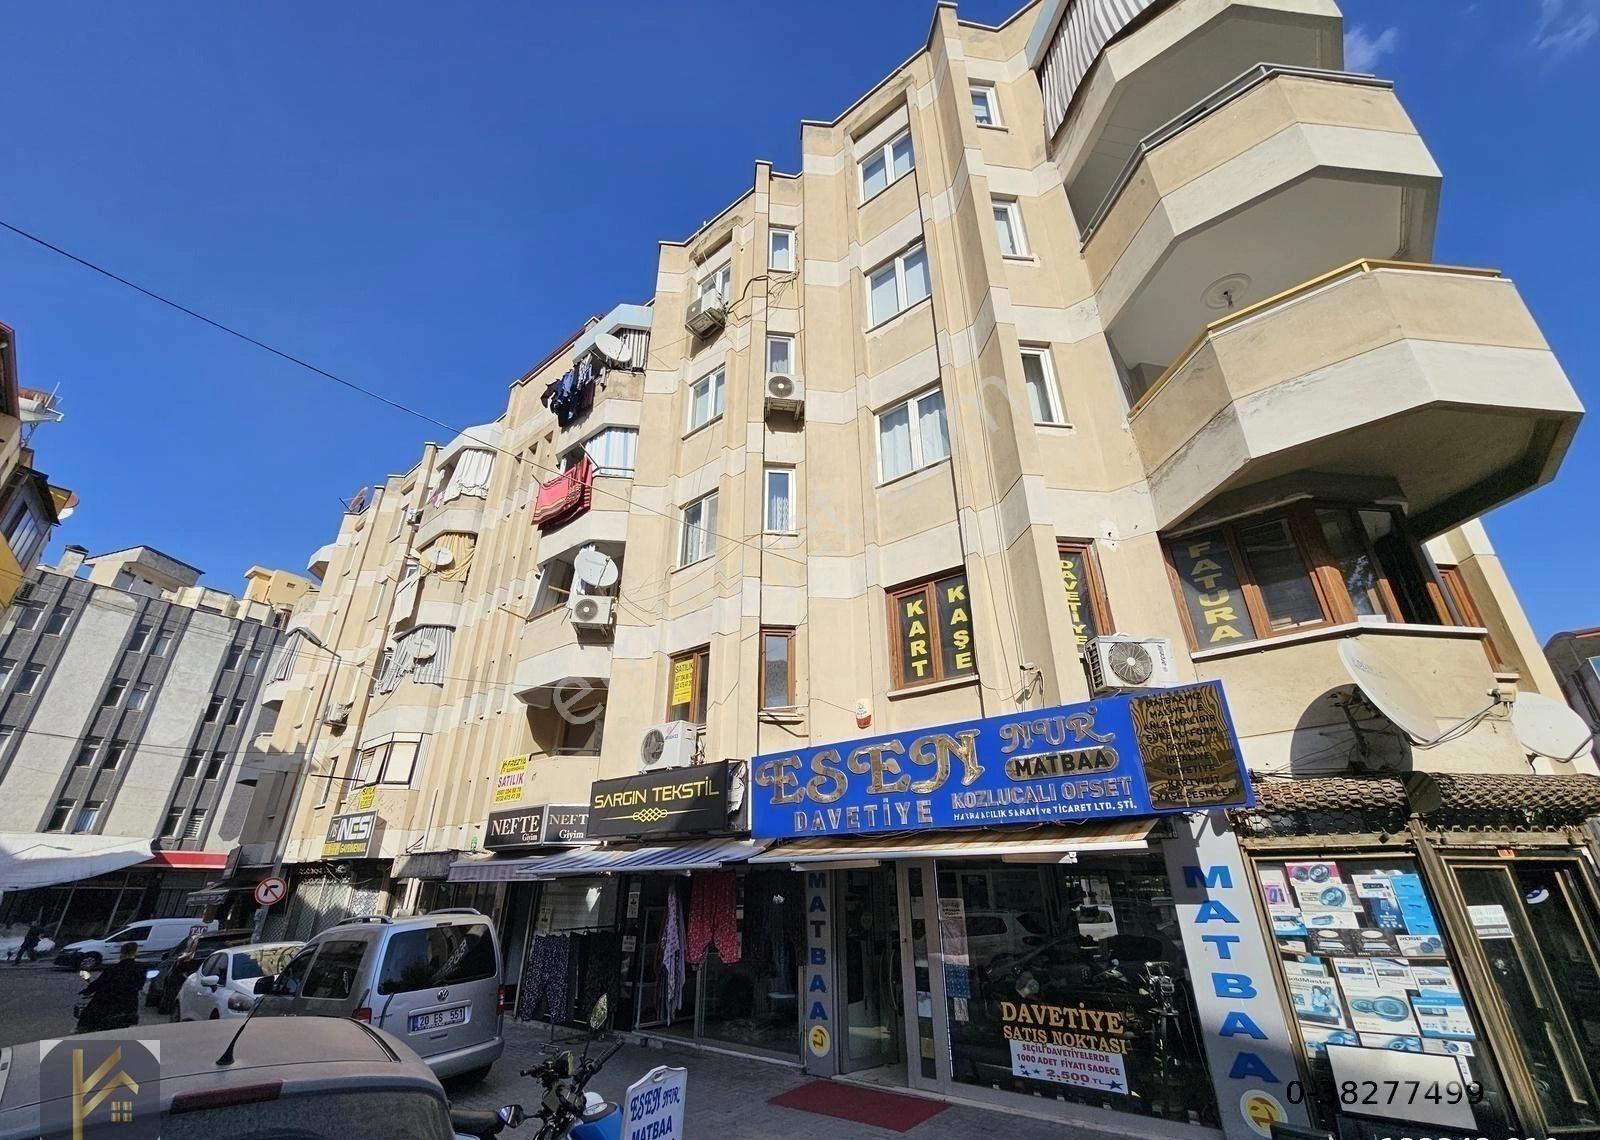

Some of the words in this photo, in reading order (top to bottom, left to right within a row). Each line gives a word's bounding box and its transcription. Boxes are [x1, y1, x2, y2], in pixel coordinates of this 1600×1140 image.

[1188, 541, 1243, 642] FATURA
[906, 599, 928, 677] KART
[948, 585, 972, 670] KAŞE
[1000, 712, 1115, 754] NUR
[755, 729, 985, 804] ESEN
[1014, 750, 1111, 777] MATBAA
[497, 773, 524, 787] SATILIK
[594, 789, 647, 809] SARGIN
[652, 776, 719, 802] TEKSTİL
[951, 782, 1057, 810] KOZLUCALI
[1061, 775, 1132, 800] OFSET
[549, 814, 589, 825] NEFT
[794, 798, 933, 832] DAVETİYE
[1008, 805, 1040, 817] SANAYİ
[1053, 802, 1092, 814] TİCARET
[1094, 800, 1116, 812] LTD.
[491, 815, 540, 836] NEFTE
[559, 829, 584, 841] Giyim
[808, 872, 829, 1021] MATBAA
[1182, 865, 1281, 1084] MATBAA
[420, 1015, 430, 1026] 20
[434, 1013, 443, 1022] ES
[450, 1009, 463, 1020] 551
[1001, 1002, 1124, 1034] DAVETİYE
[1003, 1025, 1048, 1046] SATIŞ
[1052, 1030, 1129, 1055] NOKTASI
[1047, 1046, 1111, 1063] DAVETİYELERDE
[1016, 1053, 1036, 1064] 1000
[1037, 1057, 1057, 1067] ADET
[1061, 1057, 1086, 1071] FİYATI
[1088, 1063, 1120, 1076] SADECE
[1046, 1068, 1090, 1083] 2.500
[631, 1087, 662, 1122] ESEN
[662, 1087, 681, 1108] NUR
[632, 1115, 673, 1140] MATBAA
